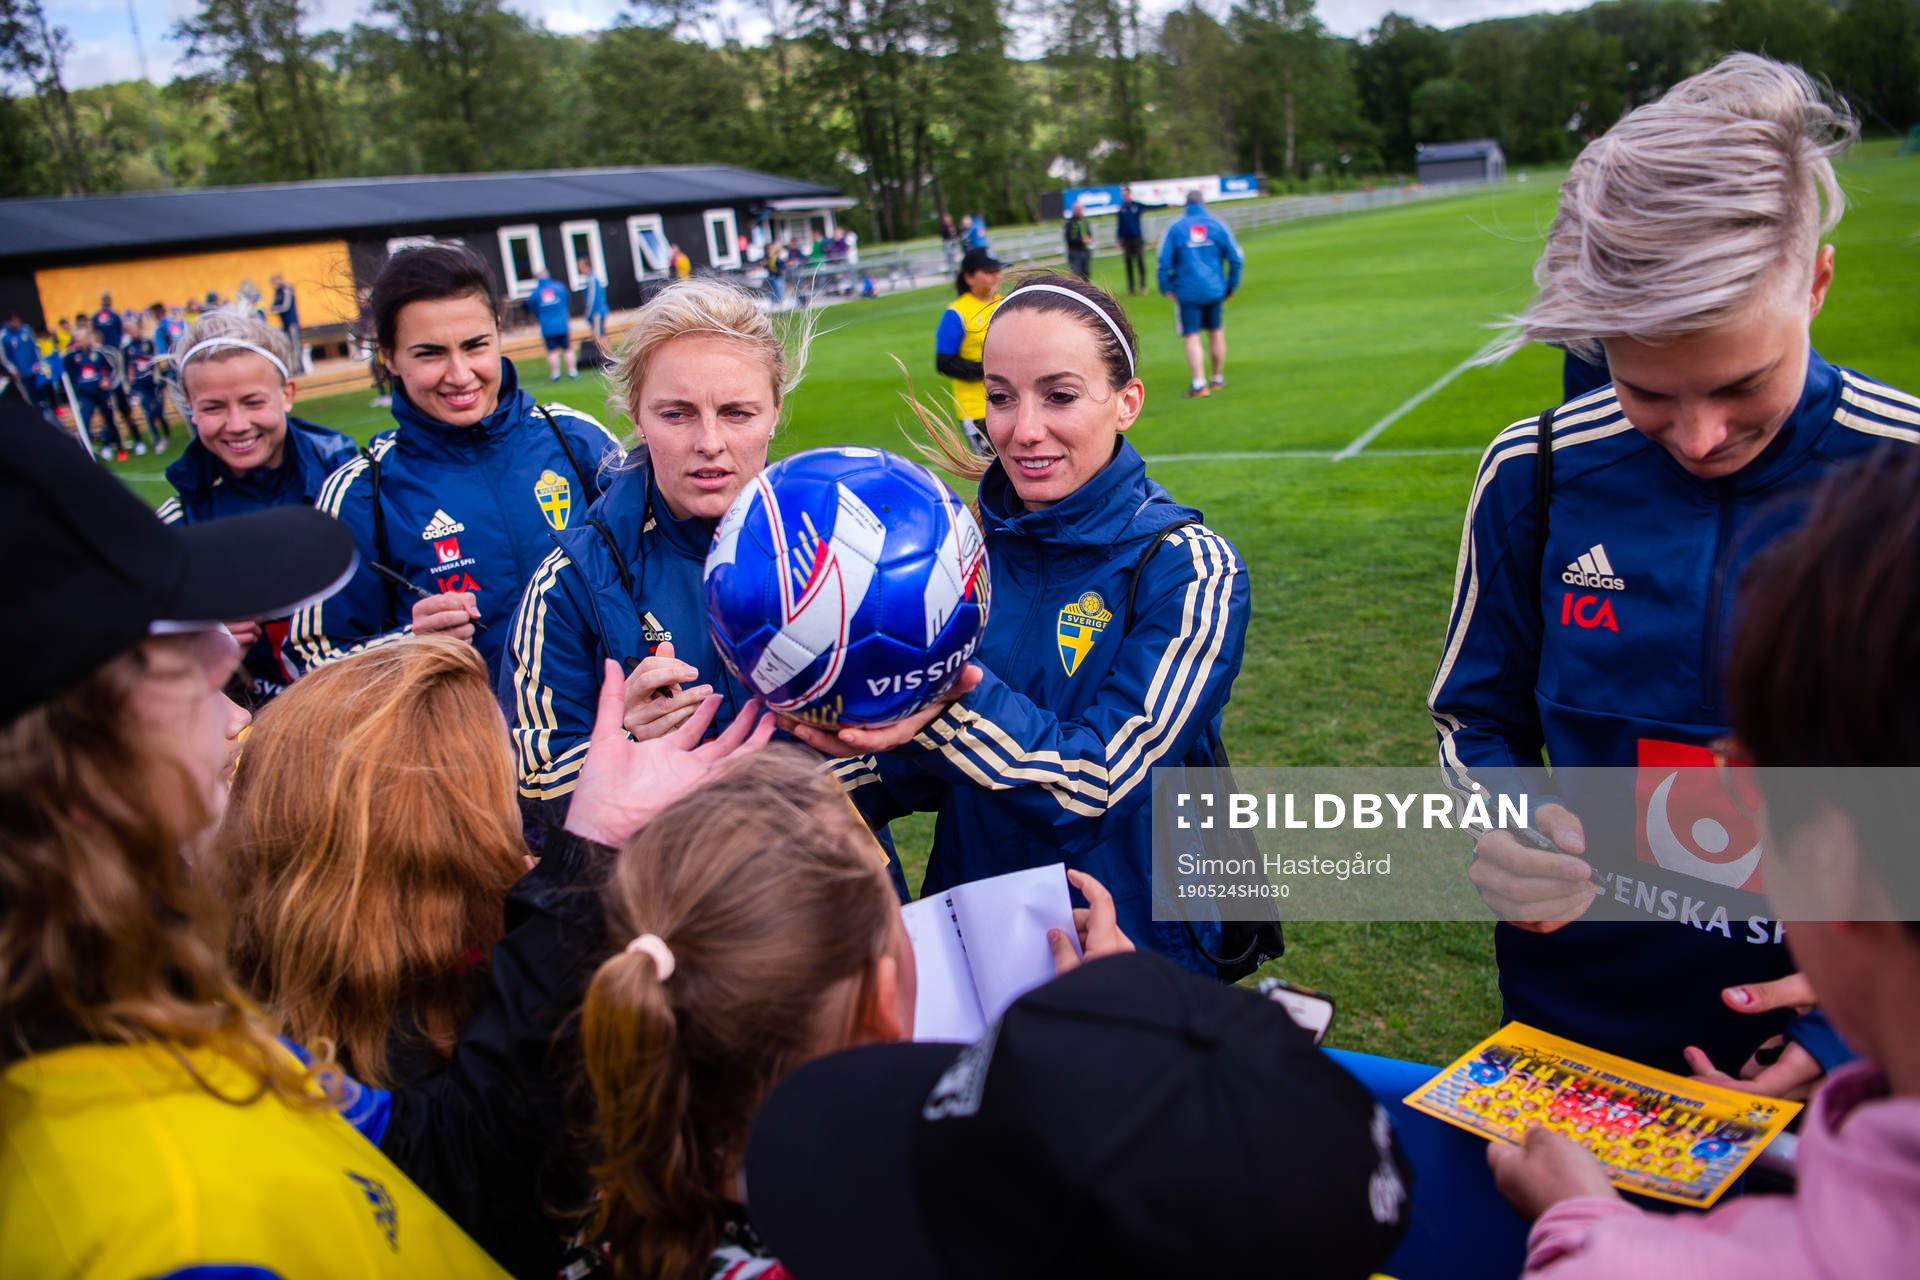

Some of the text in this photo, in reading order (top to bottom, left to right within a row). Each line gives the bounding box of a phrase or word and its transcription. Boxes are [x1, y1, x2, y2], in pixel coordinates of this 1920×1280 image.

[422, 522, 465, 541] adidas
[438, 572, 482, 594] ICA
[1562, 571, 1625, 591] adidas
[1561, 592, 1620, 633] ICA
[867, 636, 976, 697] RUSSIA
[1592, 867, 1732, 939] ENSKA
